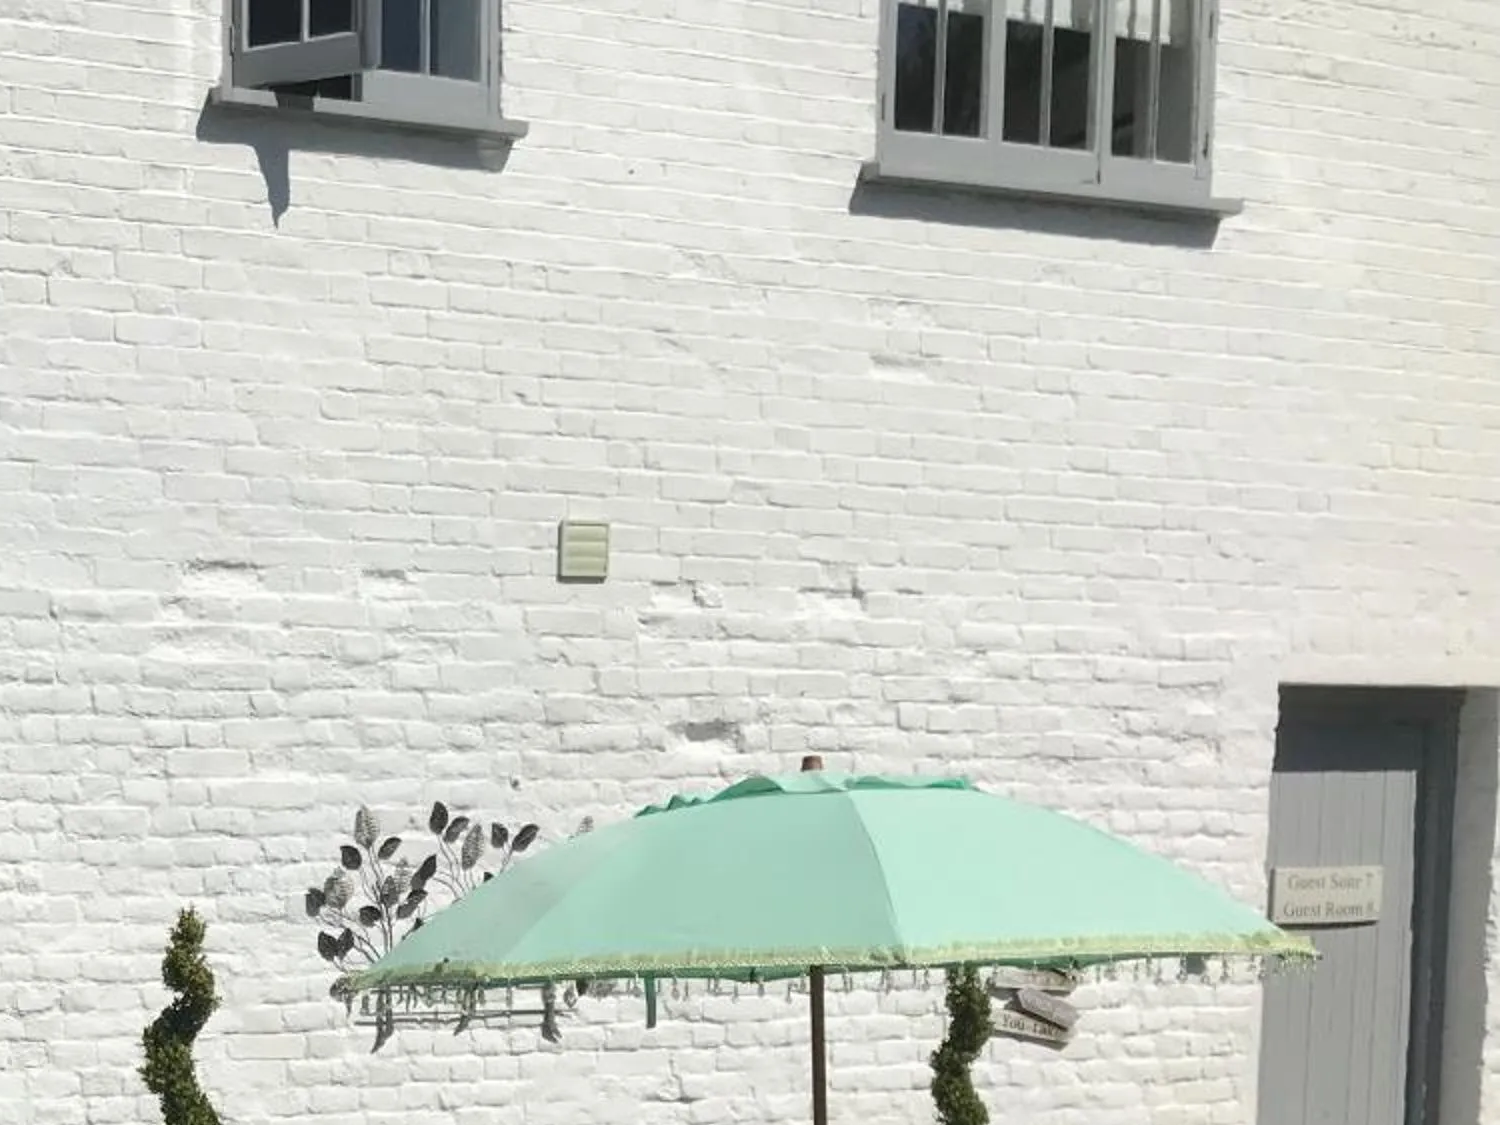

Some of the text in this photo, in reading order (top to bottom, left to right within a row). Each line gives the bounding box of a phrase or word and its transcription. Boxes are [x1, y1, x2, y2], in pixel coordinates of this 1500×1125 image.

[1287, 873, 1325, 890] Guest
[1283, 902, 1321, 918] Guest
[1325, 901, 1363, 917] Room
